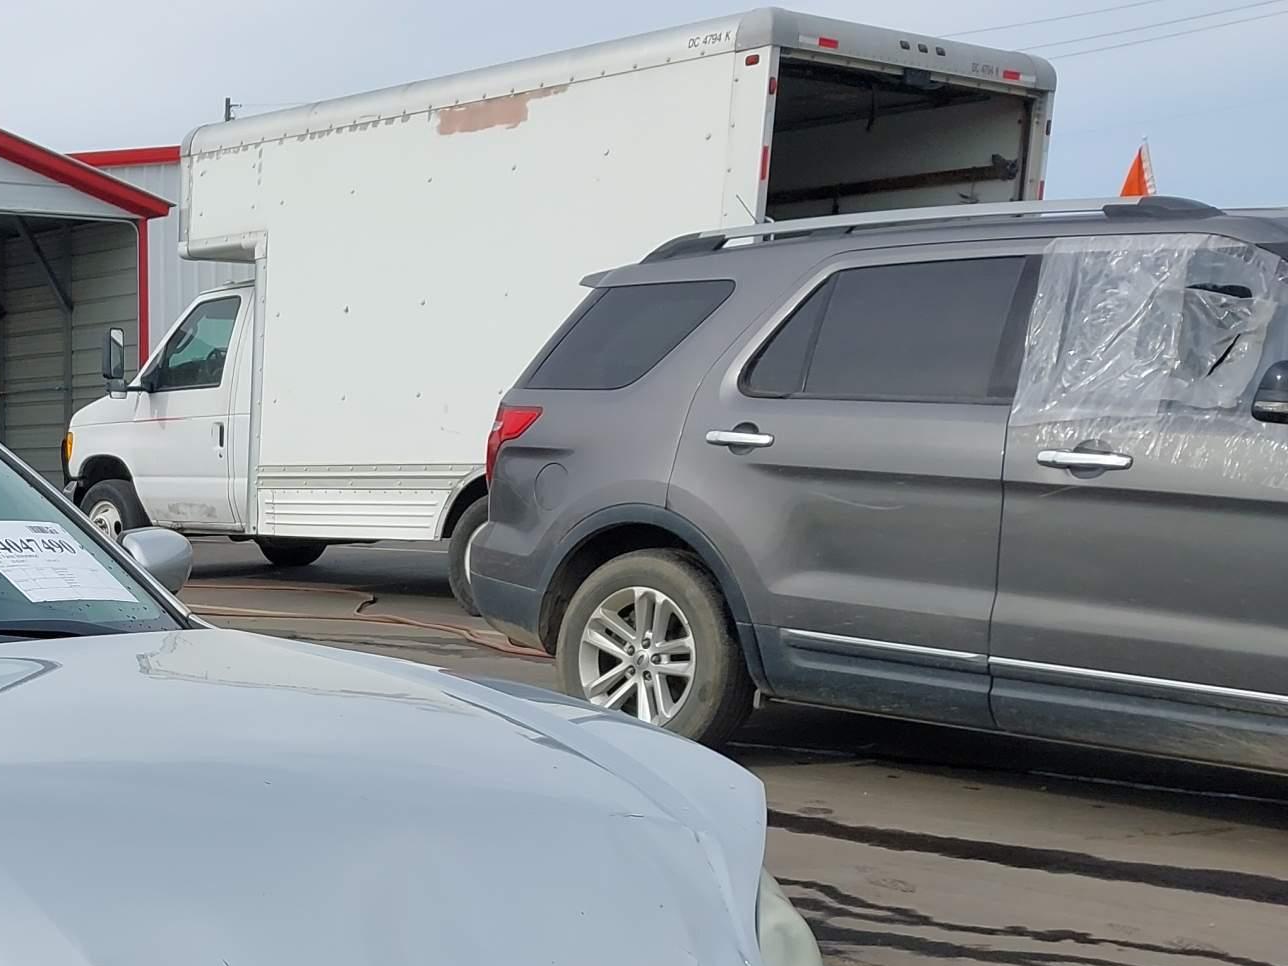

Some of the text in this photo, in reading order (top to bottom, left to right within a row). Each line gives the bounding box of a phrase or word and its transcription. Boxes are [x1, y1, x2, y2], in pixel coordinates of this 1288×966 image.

[688, 31, 731, 49] DC 4794 K
